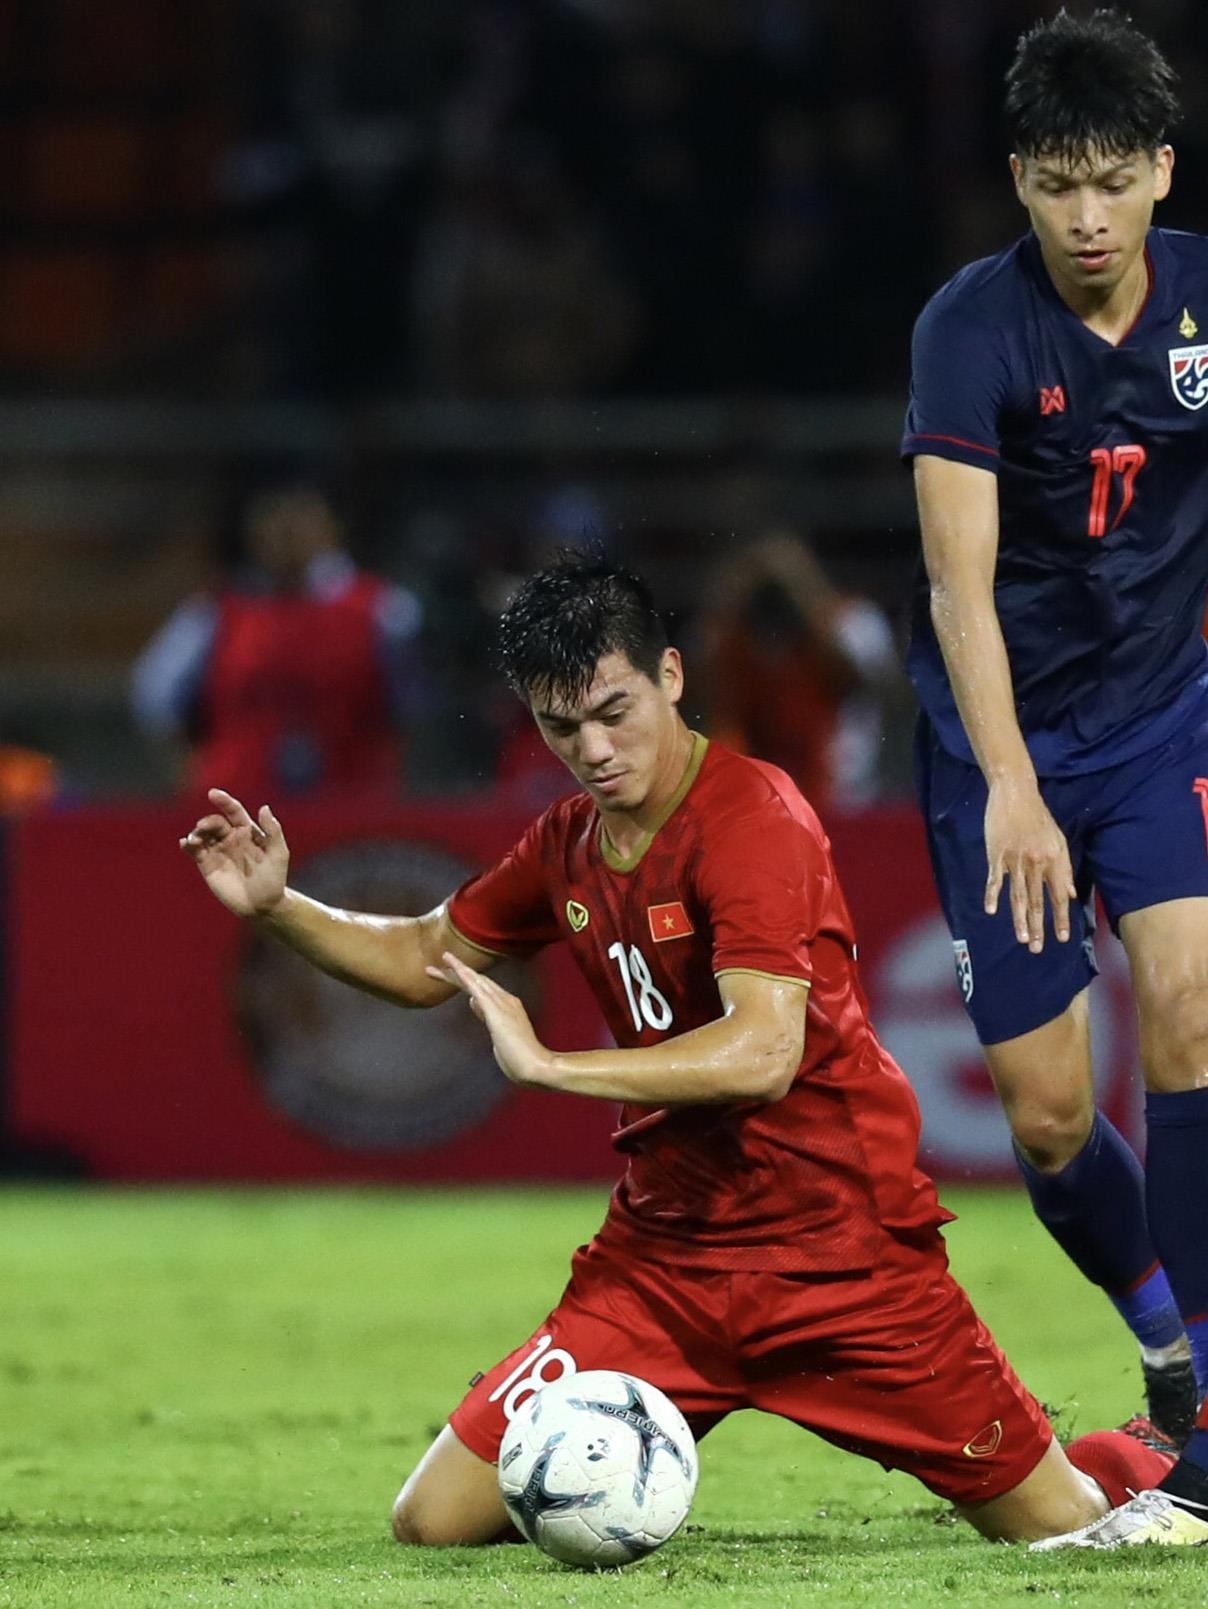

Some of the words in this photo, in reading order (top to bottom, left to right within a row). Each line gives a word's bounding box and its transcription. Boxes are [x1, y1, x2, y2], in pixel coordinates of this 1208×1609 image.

[1088, 445, 1145, 537] 17
[608, 942, 673, 1032] 18
[489, 1335, 577, 1422] 18
